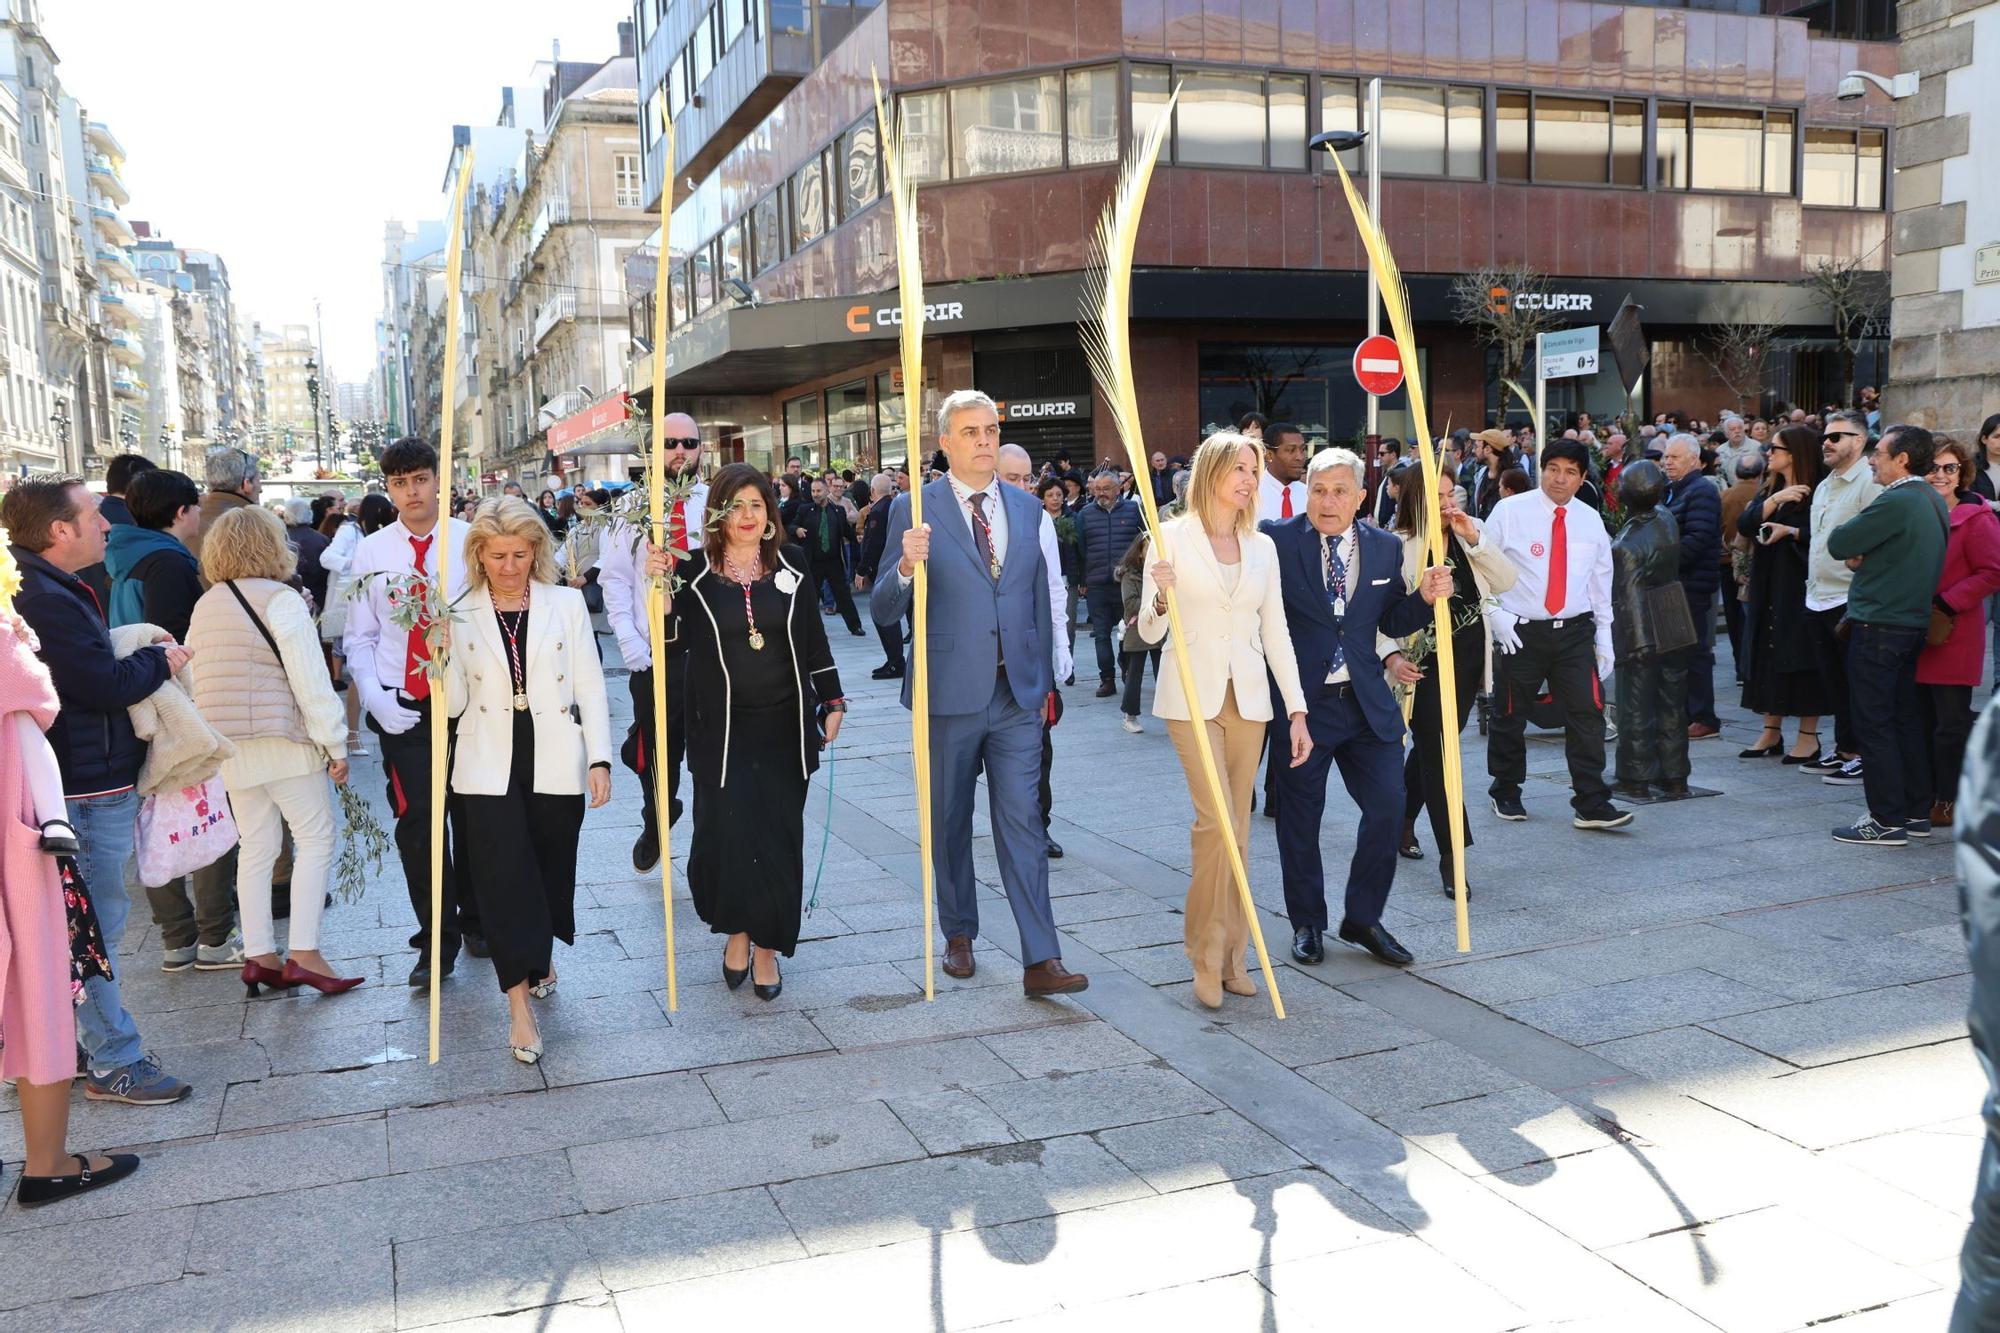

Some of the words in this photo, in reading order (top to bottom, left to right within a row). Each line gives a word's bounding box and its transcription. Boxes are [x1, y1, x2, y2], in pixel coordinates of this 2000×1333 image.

[1515, 293, 1592, 310] COURIR
[876, 302, 963, 326] CORIR
[1010, 401, 1076, 417] COURIR
